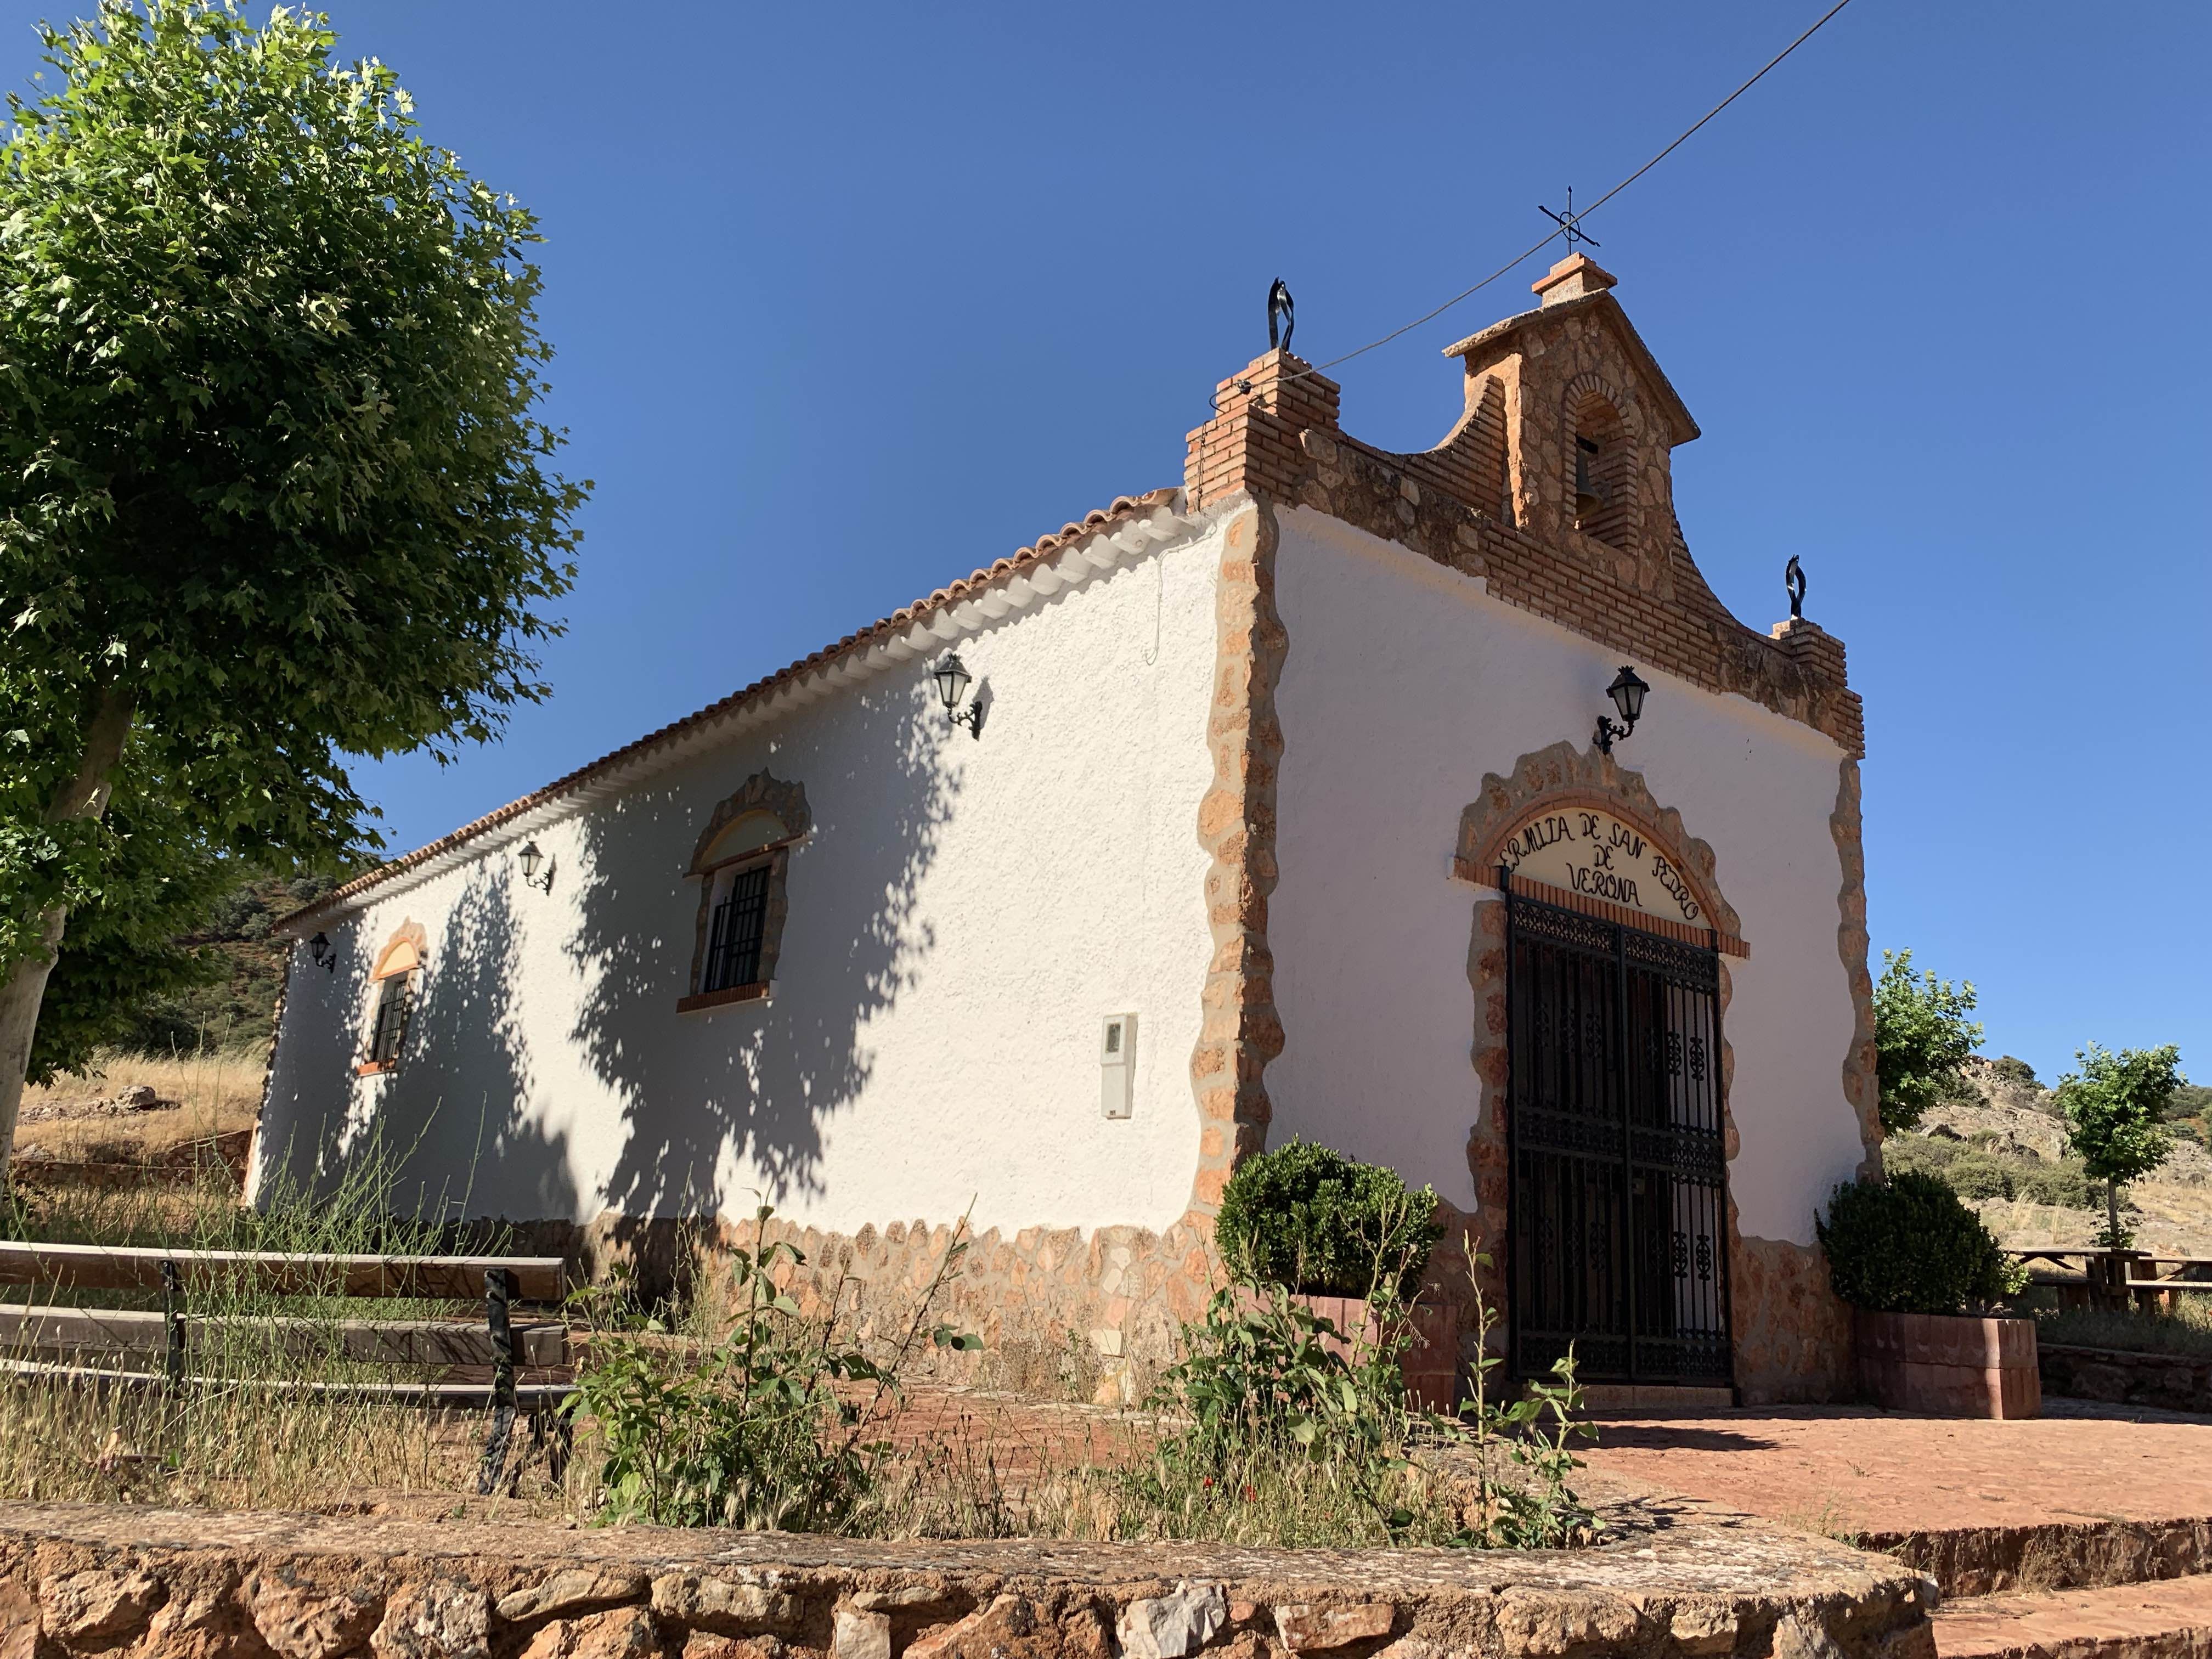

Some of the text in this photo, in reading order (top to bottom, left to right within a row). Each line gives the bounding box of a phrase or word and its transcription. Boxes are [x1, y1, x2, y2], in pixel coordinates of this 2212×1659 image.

[1499, 812, 1699, 920] ERMITA DE SAN PEDRO
[1594, 845, 1614, 870] DE
[1566, 863, 1642, 906] VERONA
